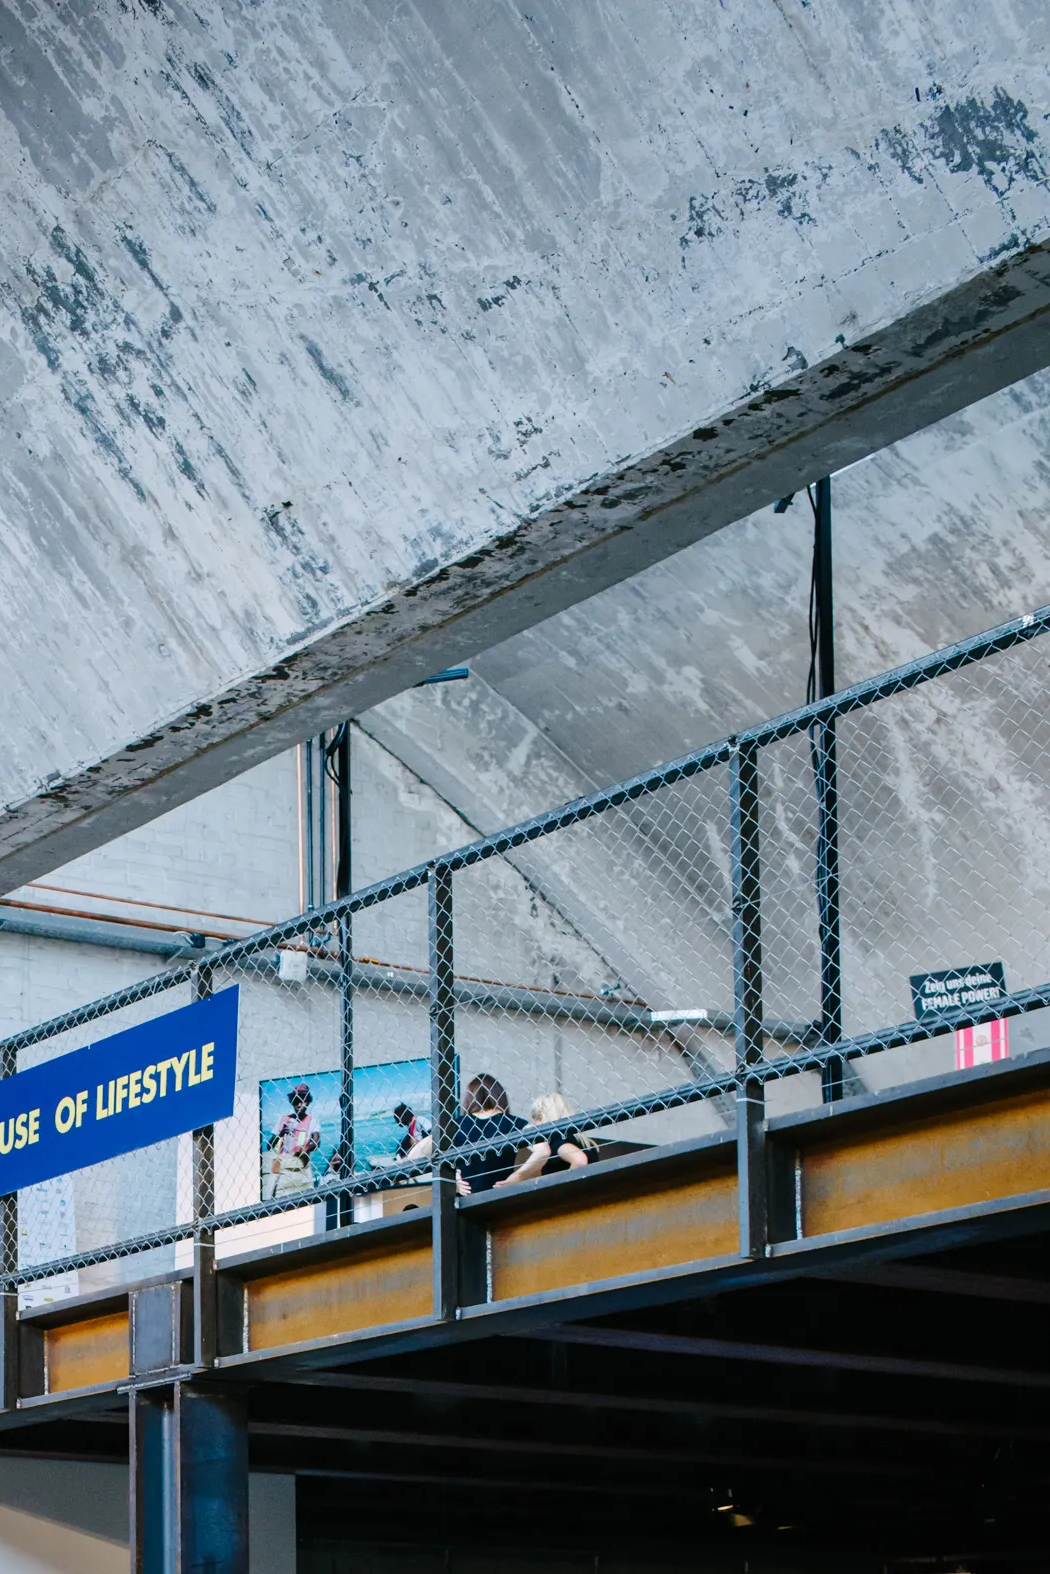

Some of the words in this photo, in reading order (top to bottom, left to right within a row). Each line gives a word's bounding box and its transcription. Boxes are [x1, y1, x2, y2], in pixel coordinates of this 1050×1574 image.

[925, 980, 946, 994] Zeig
[946, 977, 964, 990] uns
[964, 972, 992, 986] deine
[921, 992, 961, 1010] FEMALE
[961, 986, 1000, 1004] POWER!
[54, 1090, 88, 1134] OF
[96, 1041, 215, 1121] LIFESTYLE
